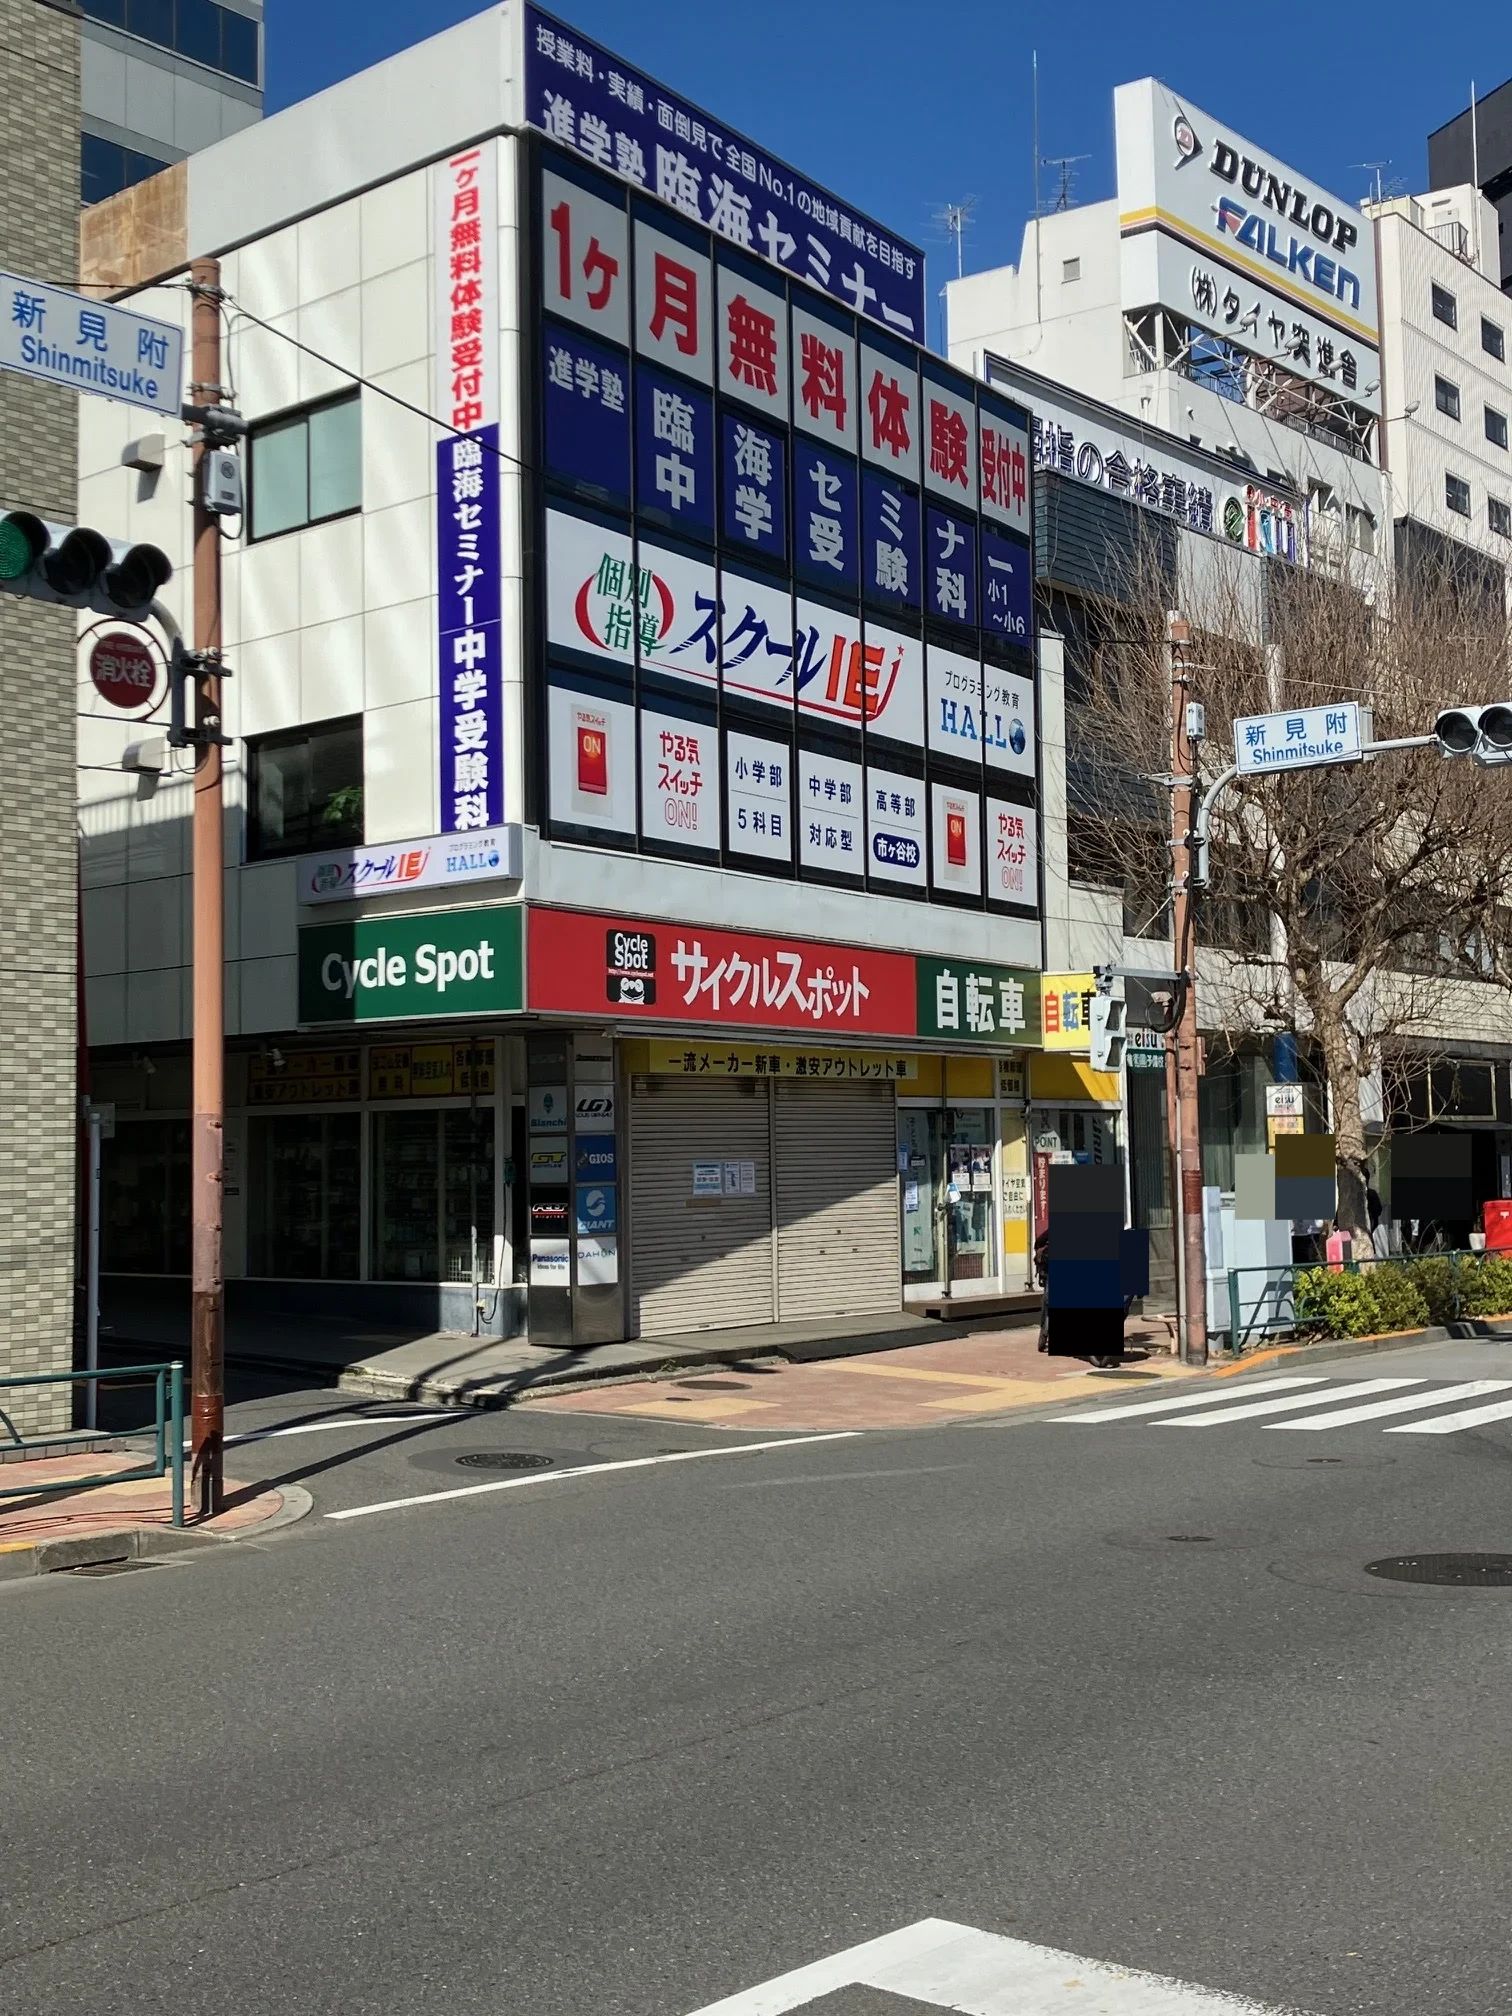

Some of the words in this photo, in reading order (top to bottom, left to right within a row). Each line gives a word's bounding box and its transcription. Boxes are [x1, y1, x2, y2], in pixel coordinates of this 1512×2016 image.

[543, 90, 646, 186] 進学塾
[1210, 139, 1358, 252] DUNLOP
[1216, 195, 1360, 310] FALKEN
[12, 290, 169, 370] 新見附
[20, 334, 159, 400] Shinmitsuke
[549, 346, 625, 414] 進学塾
[596, 552, 653, 609] 個別
[604, 603, 667, 657] 指導
[95, 652, 153, 689] 消火栓
[1245, 711, 1348, 747] 新見附
[583, 735, 602, 755] ON
[659, 730, 700, 765] やる気
[1252, 739, 1344, 765] Shinmitsuke
[657, 763, 703, 797] スイッチ
[735, 756, 782, 788] 小学部
[809, 774, 852, 805] 中学部
[876, 789, 916, 818] 高等部
[664, 797, 698, 830] ON!
[738, 808, 782, 838] 5科目
[998, 812, 1025, 840] やる気
[809, 822, 853, 852] 対応型
[950, 823, 962, 836] ON
[997, 839, 1027, 865] スイッチ
[614, 932, 648, 953] Cycle
[321, 947, 406, 999] Cycle
[415, 940, 494, 992] Spot
[614, 948, 648, 970] Spot
[671, 940, 870, 1019] サイクルスポット
[936, 968, 1026, 1034] 自転車
[668, 1051, 907, 1078] 一流メーカー新車・激安アウトレット車
[531, 1118, 567, 1127] Bianchi
[1035, 1136, 1058, 1148] POINT
[589, 1153, 614, 1165] GIOS
[578, 1219, 616, 1229] GIANT
[532, 1253, 569, 1263] Panasonic
